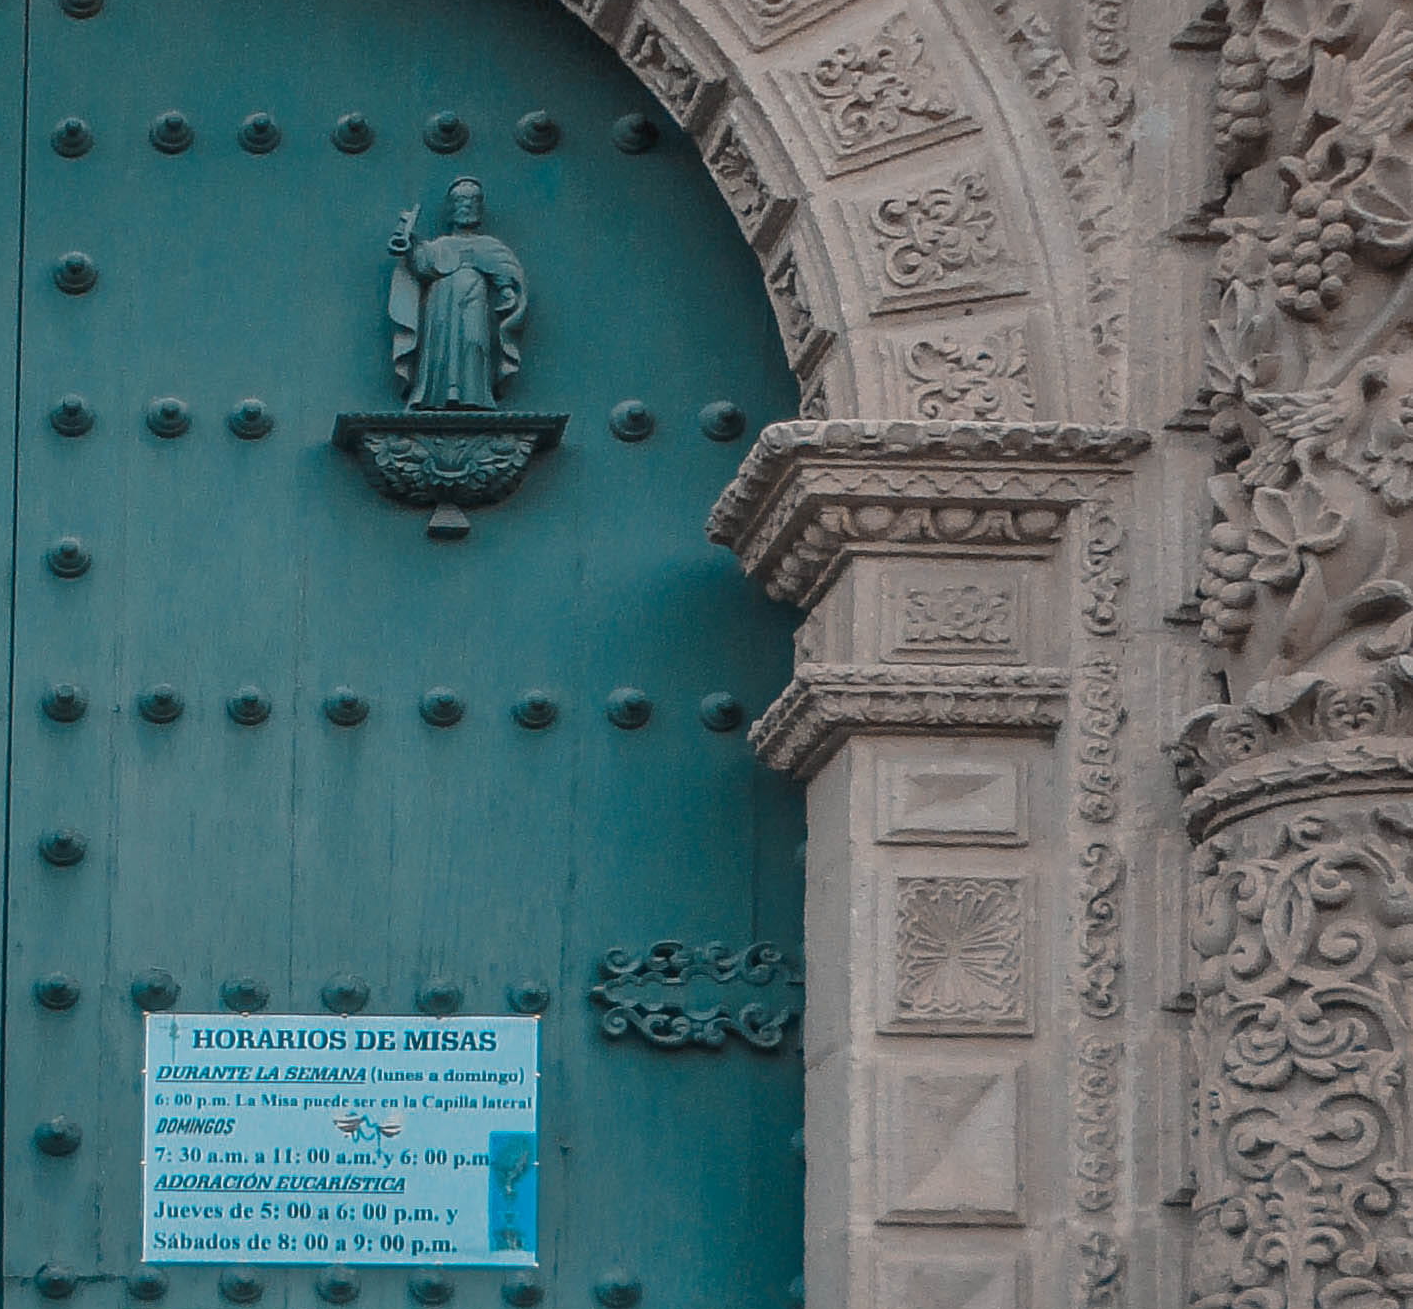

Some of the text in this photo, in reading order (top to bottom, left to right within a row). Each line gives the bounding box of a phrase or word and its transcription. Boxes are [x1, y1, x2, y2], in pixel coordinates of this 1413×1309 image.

[191, 1028, 498, 1052] HORARIOS DE MISAS
[155, 1065, 525, 1085] DURANTE LA SEMANA (lunes a domingo)
[196, 1096, 230, 1109] p.m.
[236, 1093, 256, 1107] La
[261, 1093, 298, 1107] Misa
[303, 1094, 350, 1110] puede
[353, 1097, 377, 1108] ser
[381, 1097, 398, 1108] en
[403, 1094, 418, 1108] la
[422, 1094, 478, 1111] Capilla
[482, 1094, 532, 1110] lateral
[154, 1116, 236, 1135] DOMINGOS
[154, 1146, 172, 1163] 7:
[179, 1147, 201, 1163] 30
[207, 1152, 248, 1164] a.m.
[254, 1152, 265, 1164] a
[273, 1147, 301, 1164] 11:
[306, 1147, 330, 1164] 00
[335, 1153, 376, 1165] a.m.
[383, 1153, 393, 1168] y
[400, 1148, 418, 1165] 6:
[424, 1148, 447, 1165] 00
[154, 1172, 406, 1191] ADORACIÓN EUCARÍSTICA
[154, 1200, 458, 1225] Jueves de 5: 00 a 6: 00 p.m. y
[154, 1231, 457, 1256] Sábados de 8: 00 a 9: 00 p.m.
